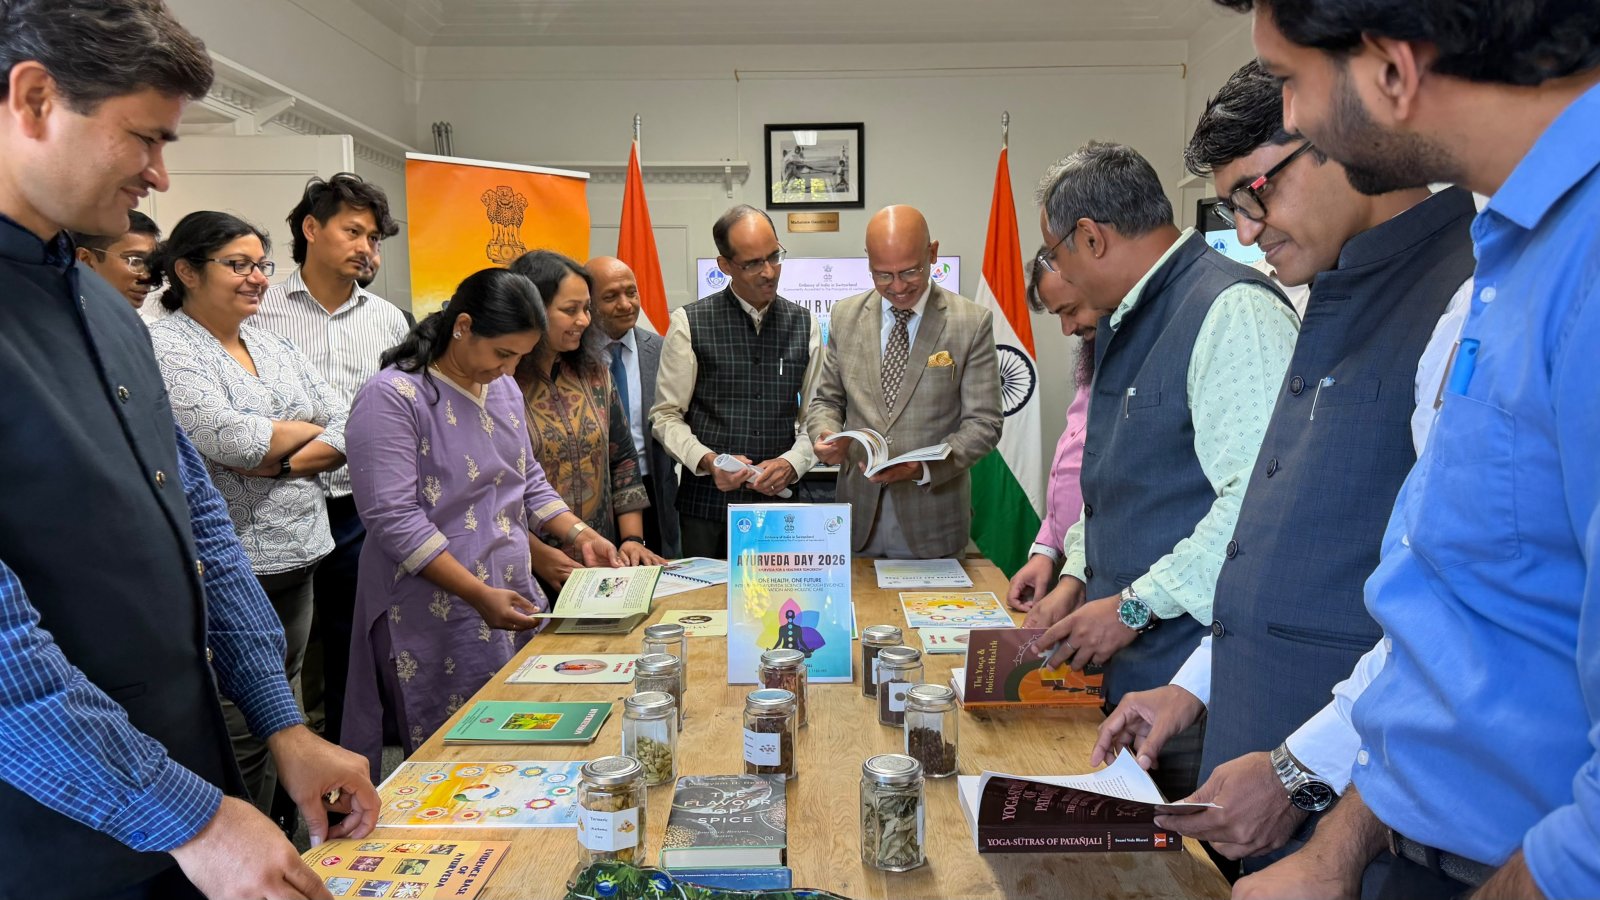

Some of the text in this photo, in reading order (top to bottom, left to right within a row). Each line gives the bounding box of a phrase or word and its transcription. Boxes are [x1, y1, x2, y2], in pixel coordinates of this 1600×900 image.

[736, 554, 846, 567] AYURVEDA DAY 2026
[683, 799, 771, 807] FLAVOUR
[697, 816, 753, 824] SPICE
[1046, 836, 1059, 846] OF
[1060, 836, 1103, 847] PATAÑJALI
[434, 852, 466, 889] AYURVEDA
[455, 848, 494, 896] EVIDENCE BASE
[457, 865, 469, 875] OF
